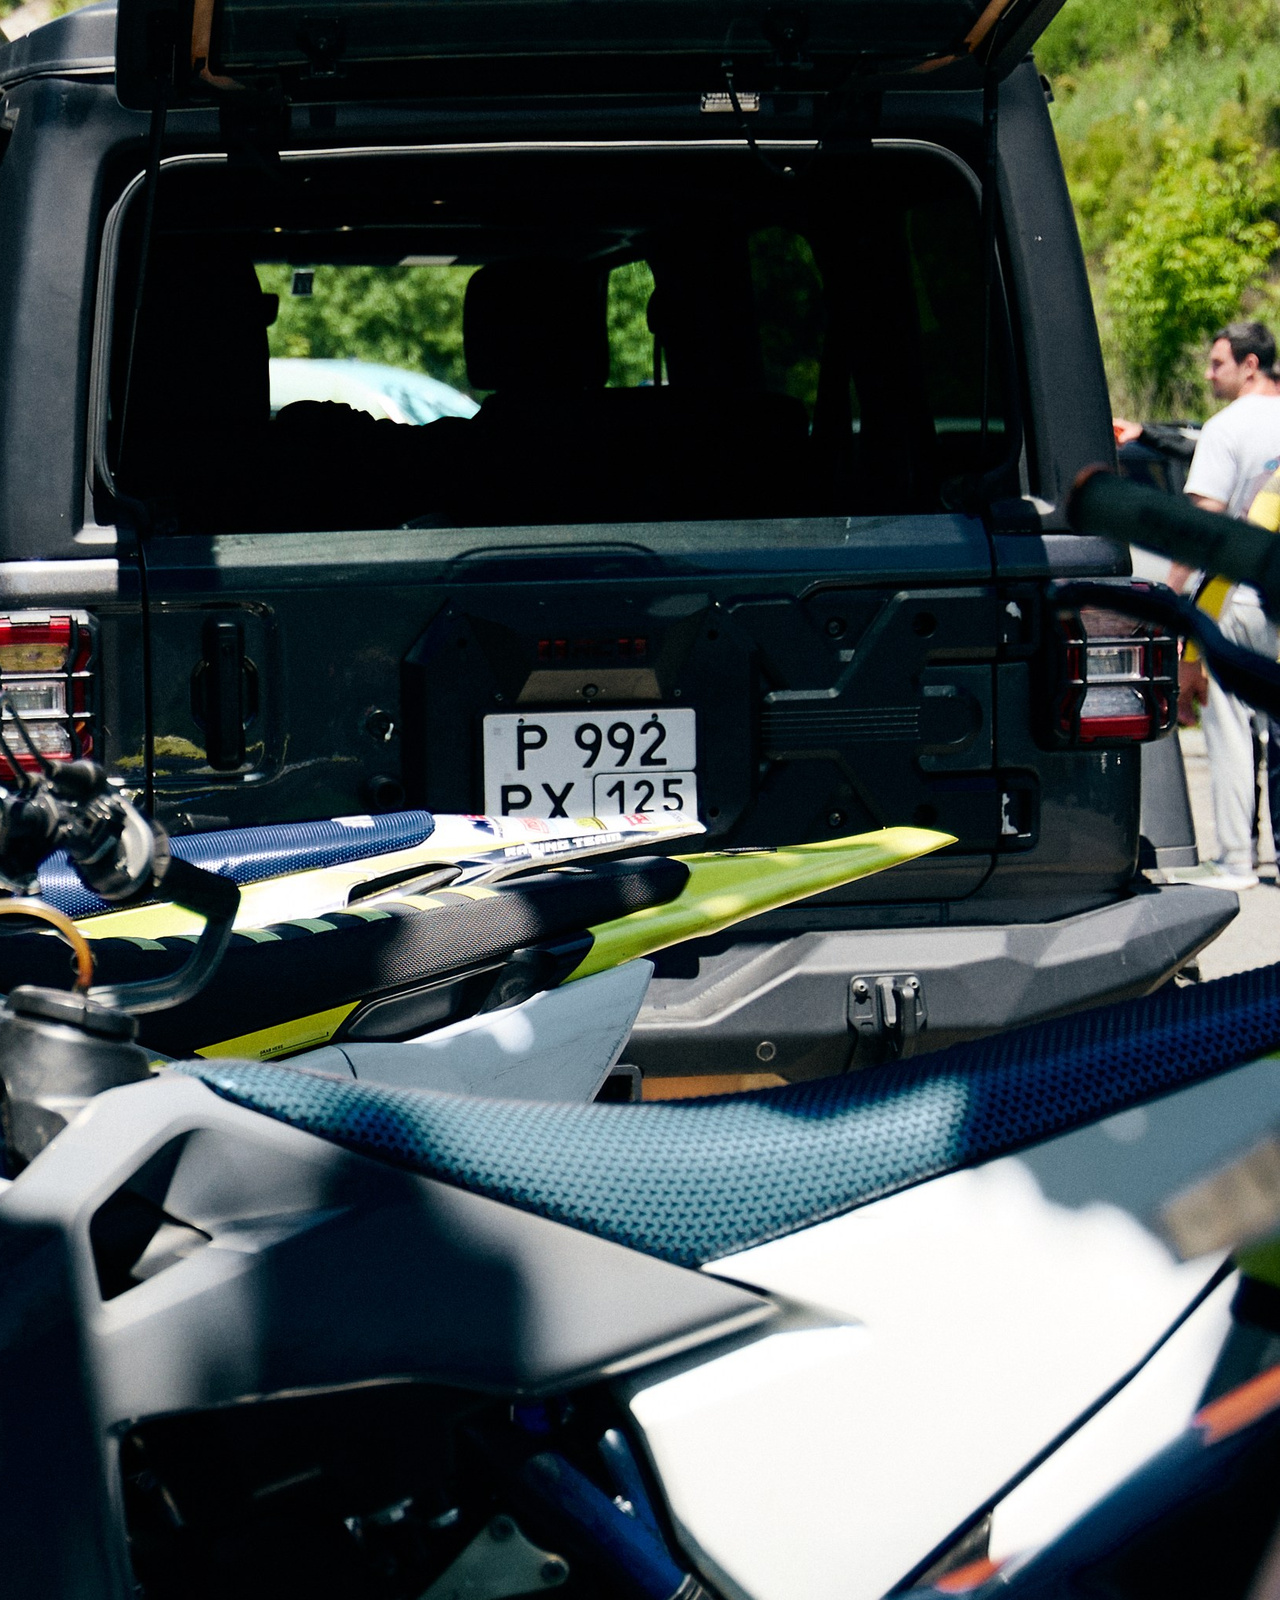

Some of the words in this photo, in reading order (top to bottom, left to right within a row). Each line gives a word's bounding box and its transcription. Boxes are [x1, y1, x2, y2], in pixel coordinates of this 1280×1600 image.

[516, 724, 548, 771] P
[574, 720, 668, 769] 992
[606, 778, 685, 815] 125
[572, 831, 622, 849] TEAM
